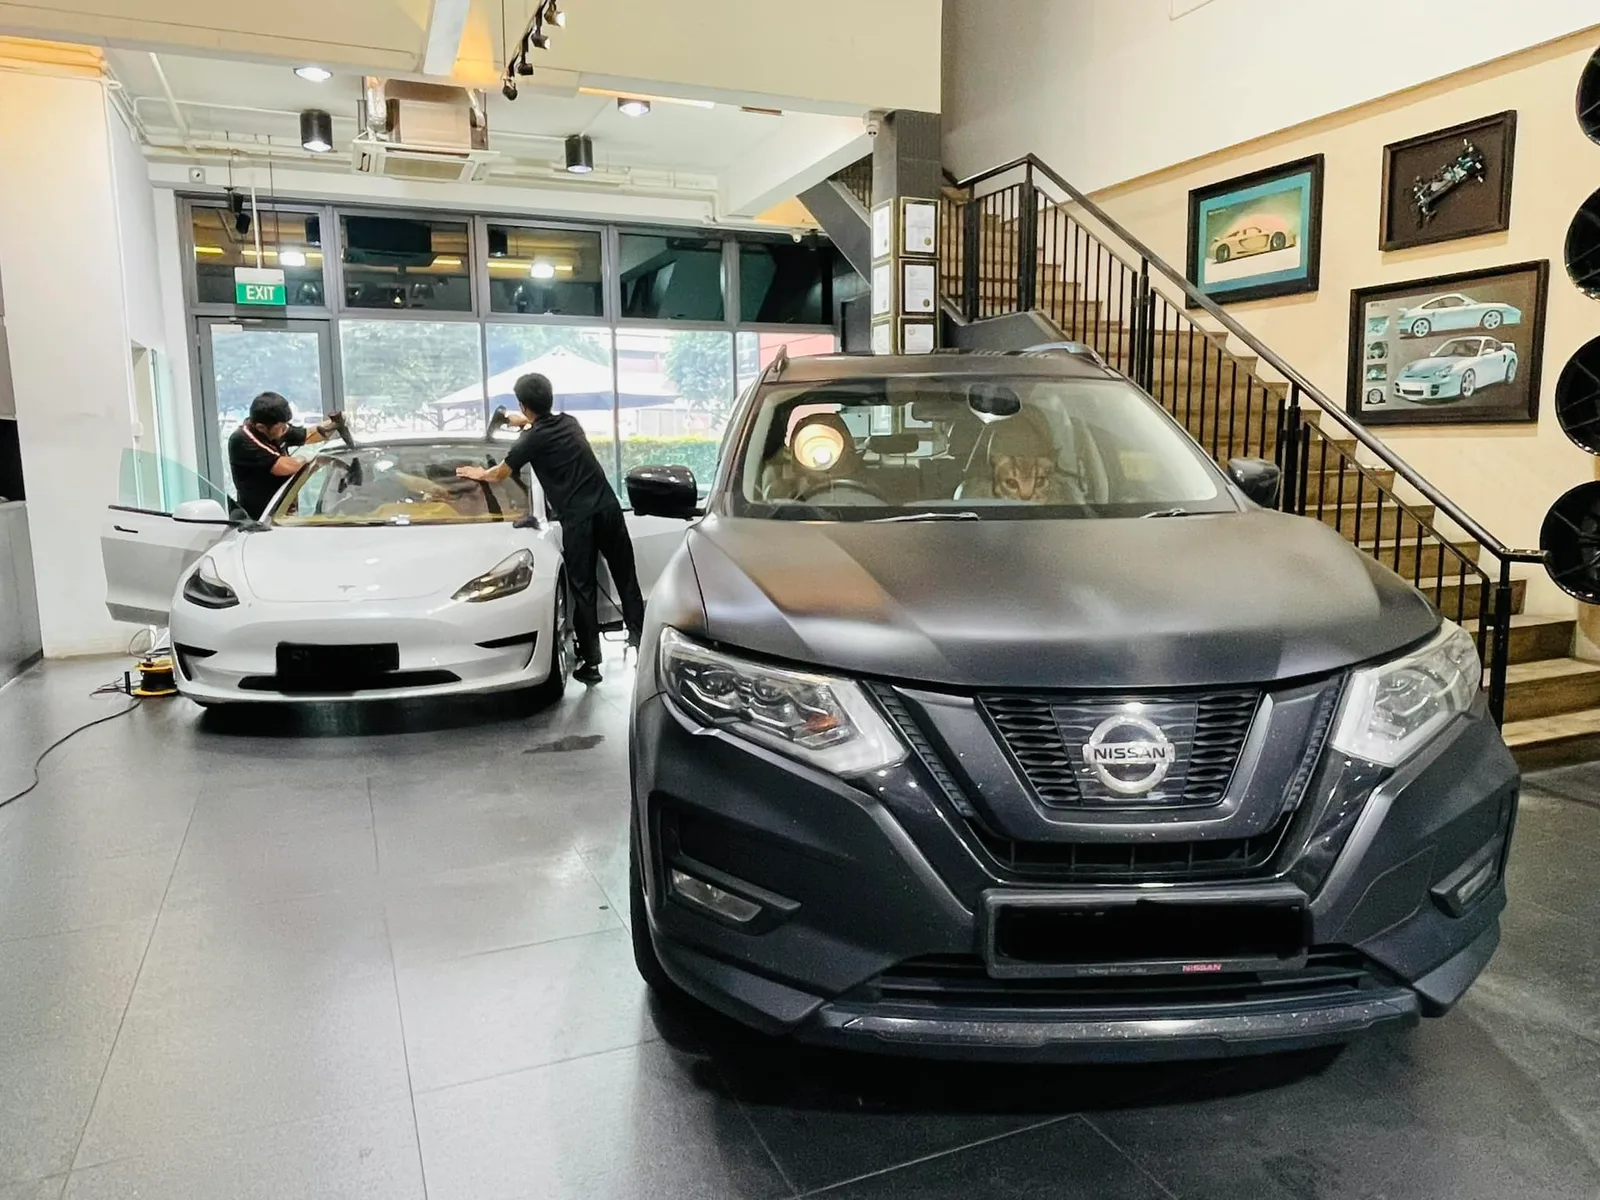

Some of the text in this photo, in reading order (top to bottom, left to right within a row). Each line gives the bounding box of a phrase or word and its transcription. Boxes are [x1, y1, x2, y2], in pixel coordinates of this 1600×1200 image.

[246, 285, 275, 301] EXIT
[1093, 747, 1166, 760] NISSAN
[1182, 963, 1222, 972] NISSAN
